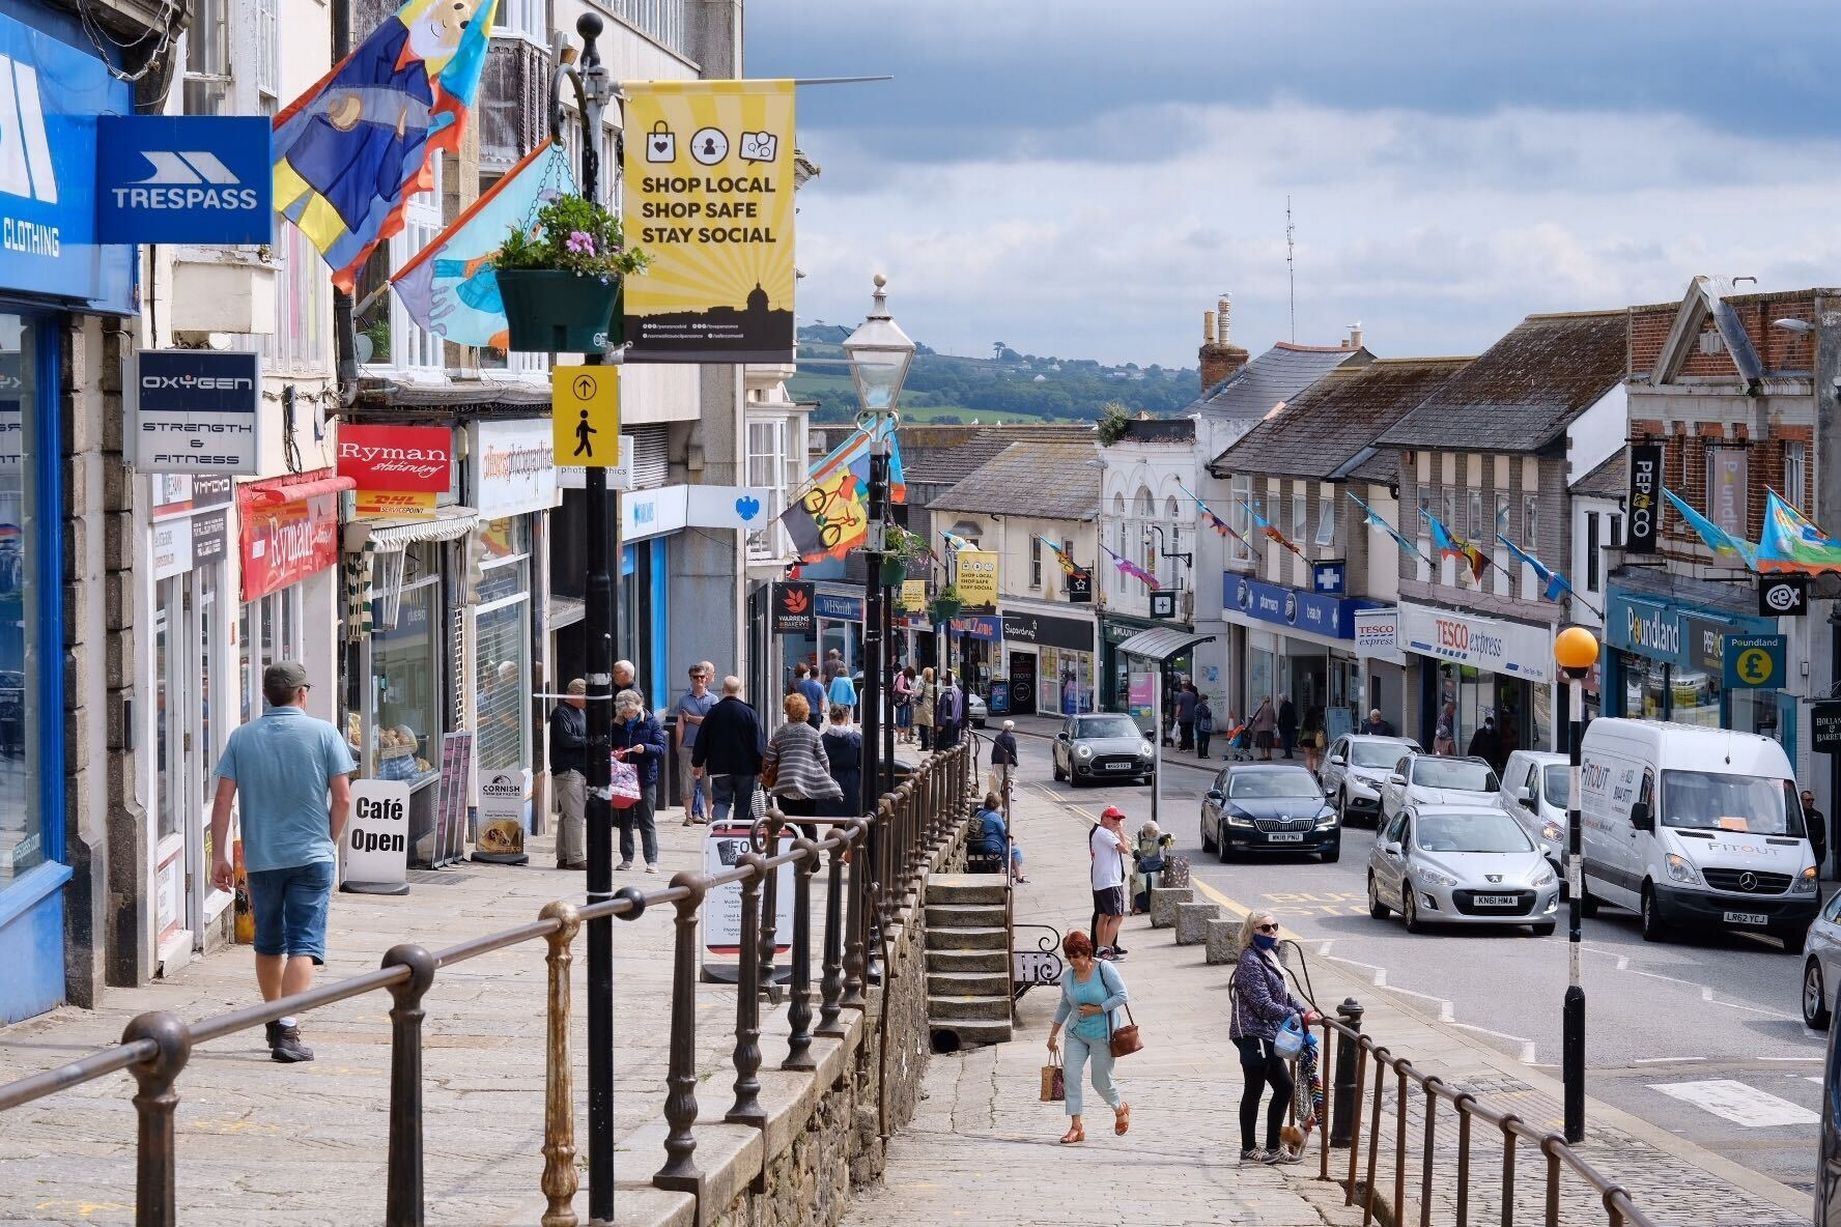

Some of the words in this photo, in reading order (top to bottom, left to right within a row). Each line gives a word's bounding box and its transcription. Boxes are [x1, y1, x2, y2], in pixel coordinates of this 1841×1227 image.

[642, 177, 702, 193] SHOP
[705, 177, 776, 193] LOCAL
[112, 188, 257, 210] TRESPASS
[642, 202, 702, 218] SHOP
[705, 202, 757, 218] SAFE
[4, 217, 60, 258] CLOTHING
[642, 227, 694, 243] STAY
[697, 227, 776, 243] SOCIAL
[142, 375, 252, 390] OXYGEN
[142, 423, 252, 433] STRENGTH
[190, 439, 205, 448] &
[154, 455, 240, 465] FITNESS
[339, 443, 448, 462] Ryman
[371, 460, 444, 478] stationery
[373, 495, 417, 504] DHL
[270, 517, 314, 576] Ryman
[823, 599, 852, 615] WHSmith
[1004, 623, 1036, 641] Superdrug
[1358, 625, 1394, 634] TESCO
[1627, 606, 1679, 654] Poundland
[1359, 637, 1394, 647] express
[1436, 619, 1469, 650] TESCO
[1469, 631, 1502, 661] express
[1731, 638, 1779, 647] Poundland
[1816, 717, 1841, 726] HOLLAN
[356, 796, 403, 820] Café
[351, 828, 405, 852] Open
[1708, 842, 1781, 856] FITOUT
[1478, 896, 1496, 905] KN61
[1727, 912, 1748, 921] LR62
[1750, 915, 1765, 923] YCJ
